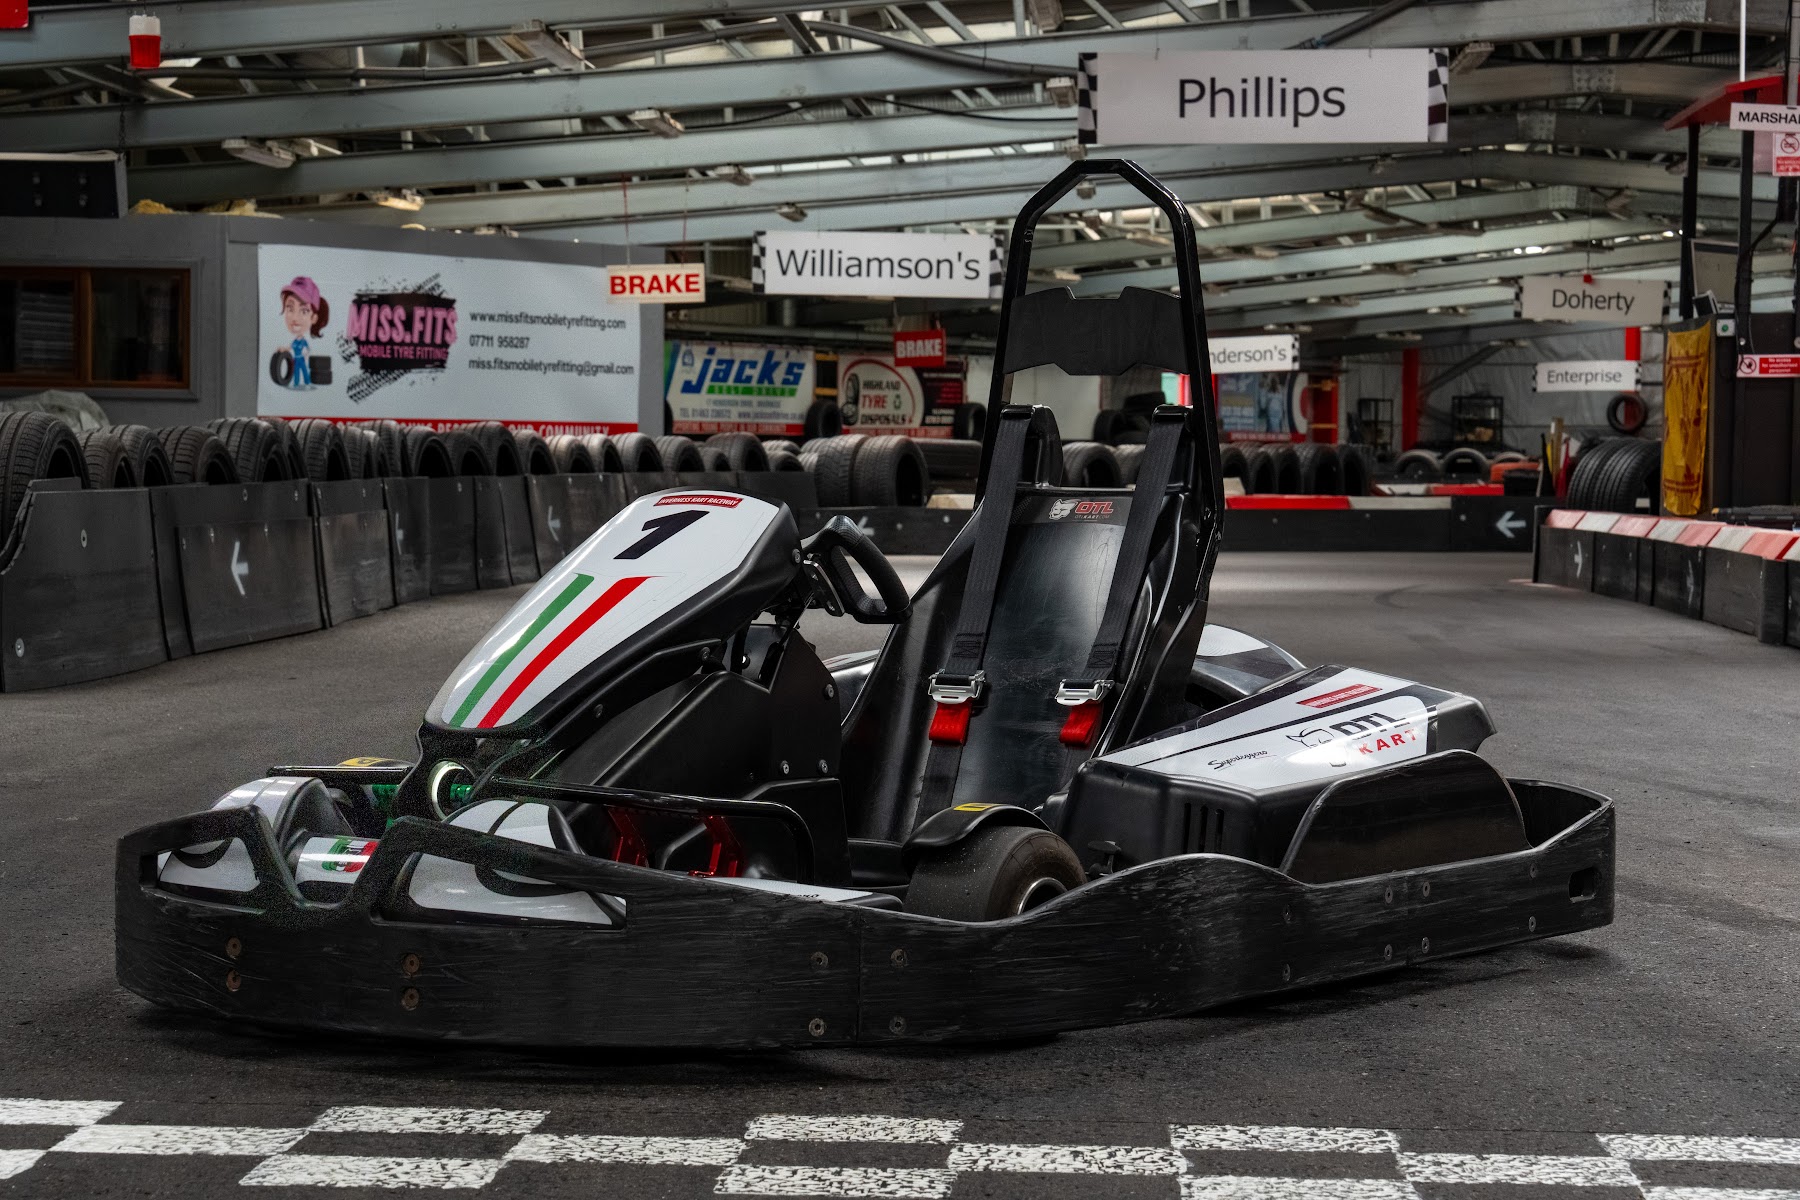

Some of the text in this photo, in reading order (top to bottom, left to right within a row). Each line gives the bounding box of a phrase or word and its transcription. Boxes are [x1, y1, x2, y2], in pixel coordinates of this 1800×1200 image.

[1177, 75, 1347, 128] Phillips
[1738, 112, 1800, 124] MARSHA
[775, 248, 981, 282] Williamson's
[610, 273, 700, 294] BRAKE
[1551, 288, 1635, 315] Doherty
[347, 304, 457, 345] MISS.FITS
[469, 311, 627, 331] www.missfitsmobiletyrefitting.com
[359, 345, 448, 361] MOBILE TYRE FITTING
[896, 339, 942, 358] BRAKE
[1209, 345, 1287, 364] nderson's
[680, 347, 806, 394] jack's
[1547, 369, 1622, 385] Enterprise
[862, 380, 901, 390] HIGHLAND
[862, 394, 888, 408] TYRE
[860, 414, 907, 425] DISPOSALS
[707, 498, 739, 506] RACEWAY
[613, 509, 710, 559] 1
[1358, 728, 1418, 756] KART
